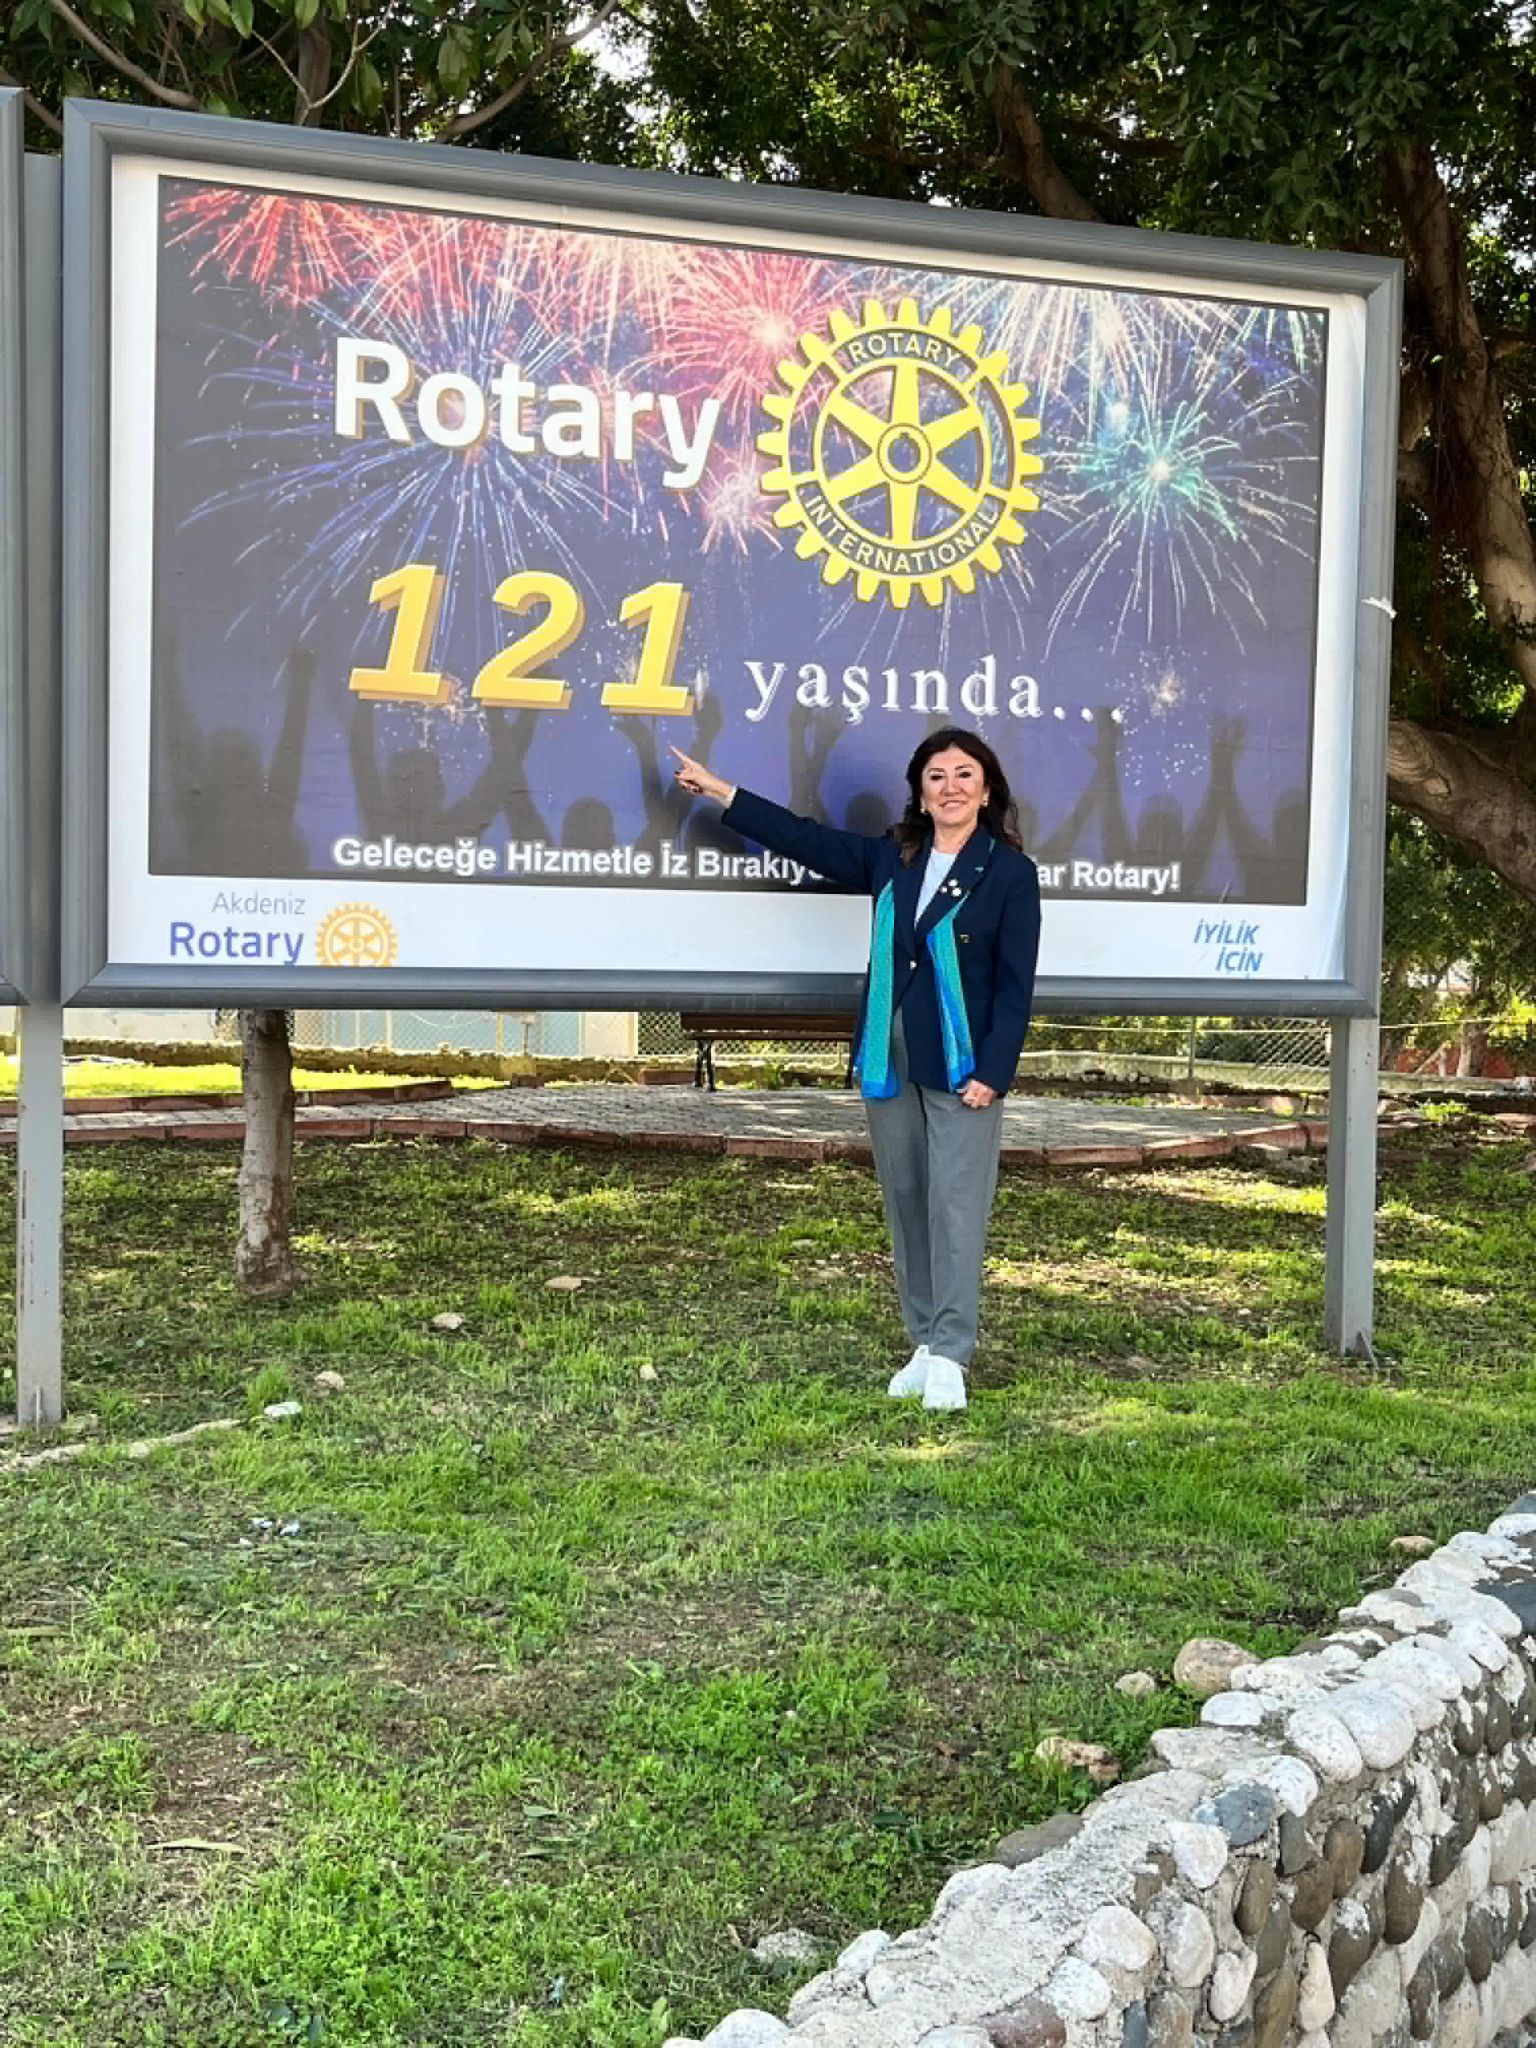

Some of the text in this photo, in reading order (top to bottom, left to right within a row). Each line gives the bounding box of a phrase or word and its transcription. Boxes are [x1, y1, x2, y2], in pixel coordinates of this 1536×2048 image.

[848, 332, 962, 368] ROTARY
[335, 337, 720, 489] Rotary
[804, 494, 999, 574] INTERNATIONAL
[349, 563, 1123, 726] 121 yaşında...
[333, 837, 497, 877] Geleceğe
[506, 841, 652, 875] Hizmetle
[661, 841, 688, 877] İz
[1031, 856, 1066, 887] ar
[1073, 860, 1181, 895] Rotary!
[211, 891, 305, 915] Akdeniz
[169, 922, 304, 966] Rotary
[1193, 918, 1260, 944] İYİLİK
